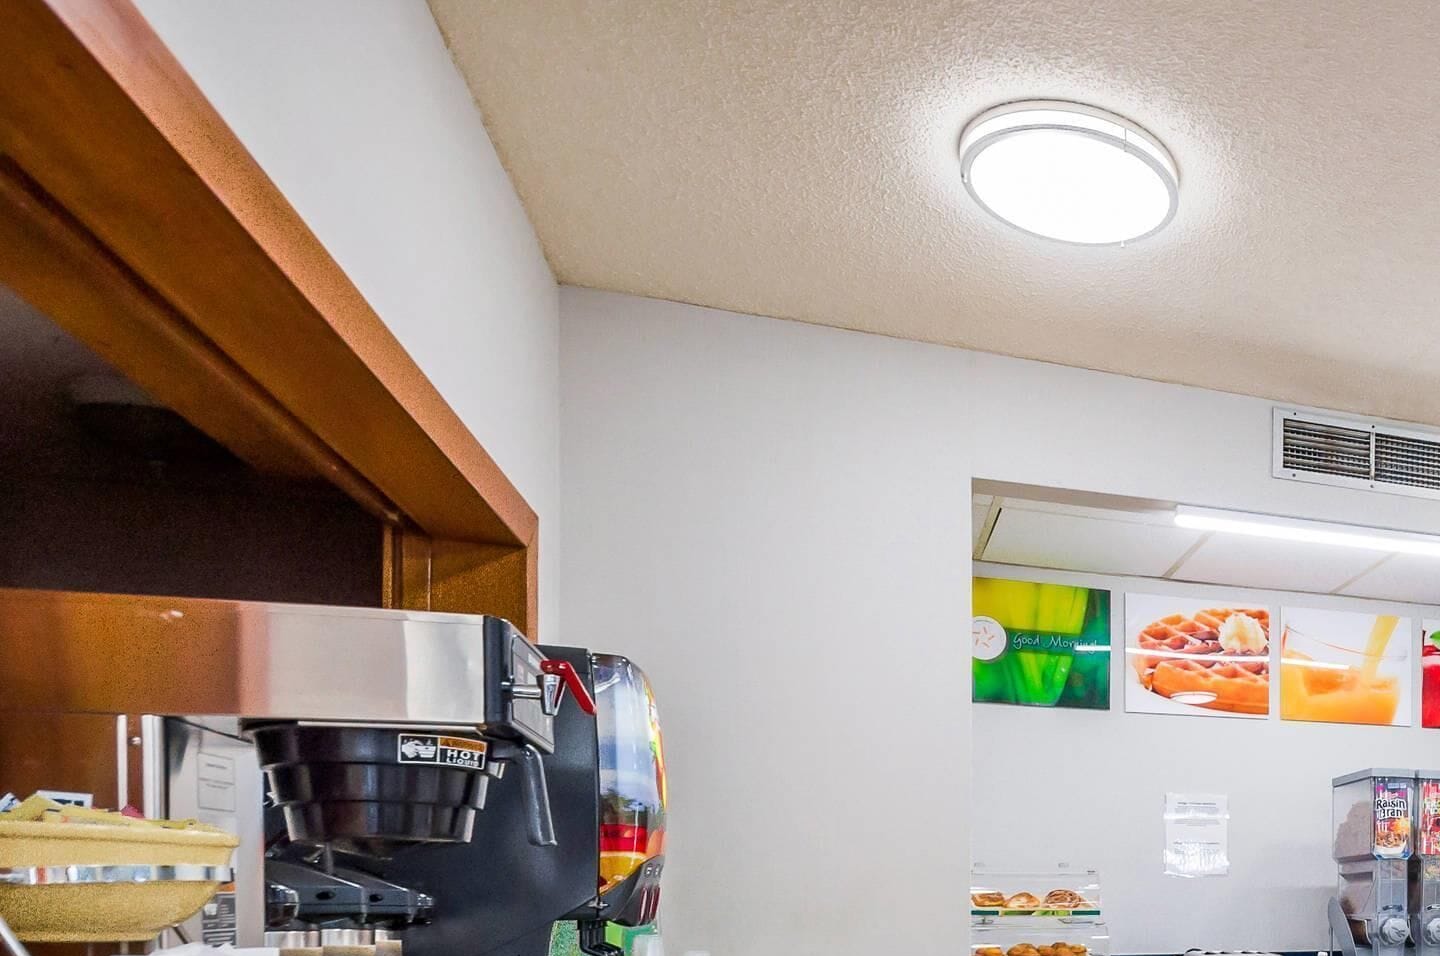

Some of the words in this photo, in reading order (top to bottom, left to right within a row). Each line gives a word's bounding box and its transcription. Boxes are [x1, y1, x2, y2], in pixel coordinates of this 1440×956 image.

[1013, 633, 1040, 649] Good
[447, 749, 481, 761] HOT
[446, 758, 480, 767] LIQUID
[1376, 798, 1406, 811] Raisin
[1379, 808, 1403, 819] Bran
